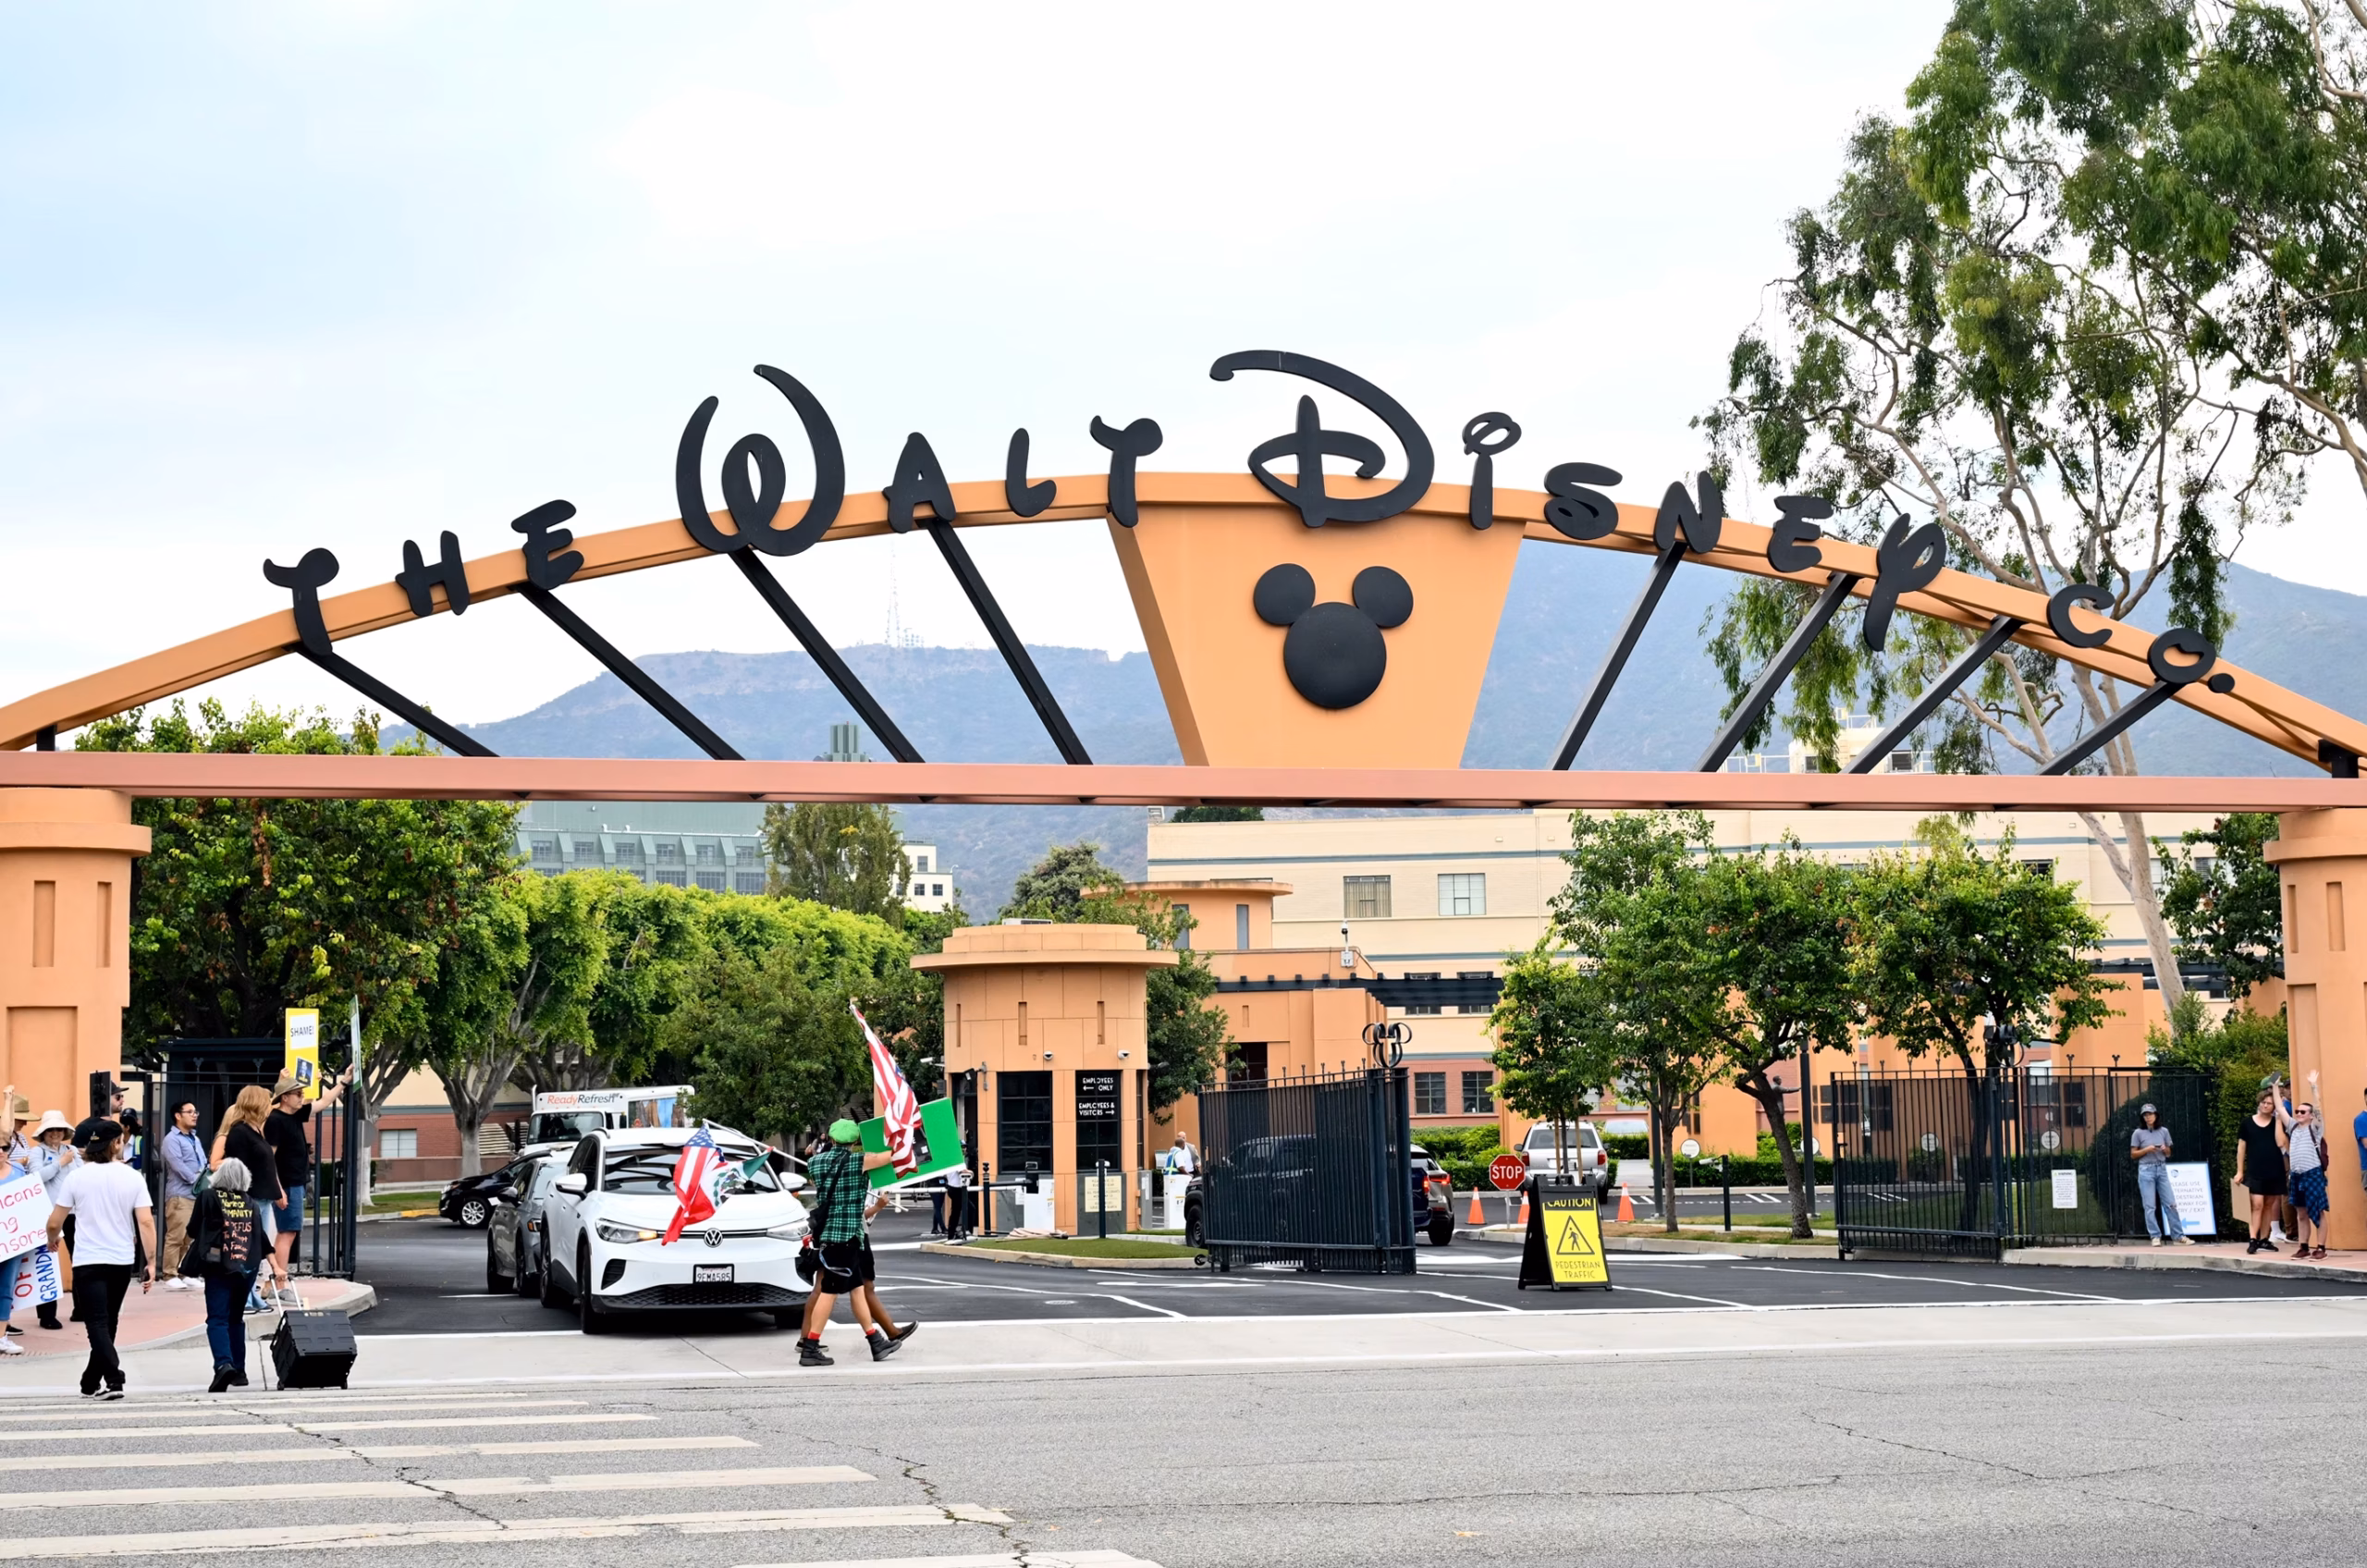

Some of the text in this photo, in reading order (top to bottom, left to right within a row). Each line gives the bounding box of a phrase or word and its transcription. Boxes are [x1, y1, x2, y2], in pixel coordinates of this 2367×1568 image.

[263, 499, 584, 655] THE
[676, 364, 1163, 557] WALT
[290, 1025, 314, 1037] SHAME!
[547, 1094, 615, 1105] ReadyRefresh
[1491, 1166, 1523, 1180] STOP
[1547, 1197, 1591, 1207] CAUTION
[0, 1229, 47, 1254] nsore
[1555, 1260, 1600, 1269] PEDESTRIAN
[696, 1272, 730, 1282] 9EMA585
[1564, 1270, 1596, 1280] TRAFFIC
